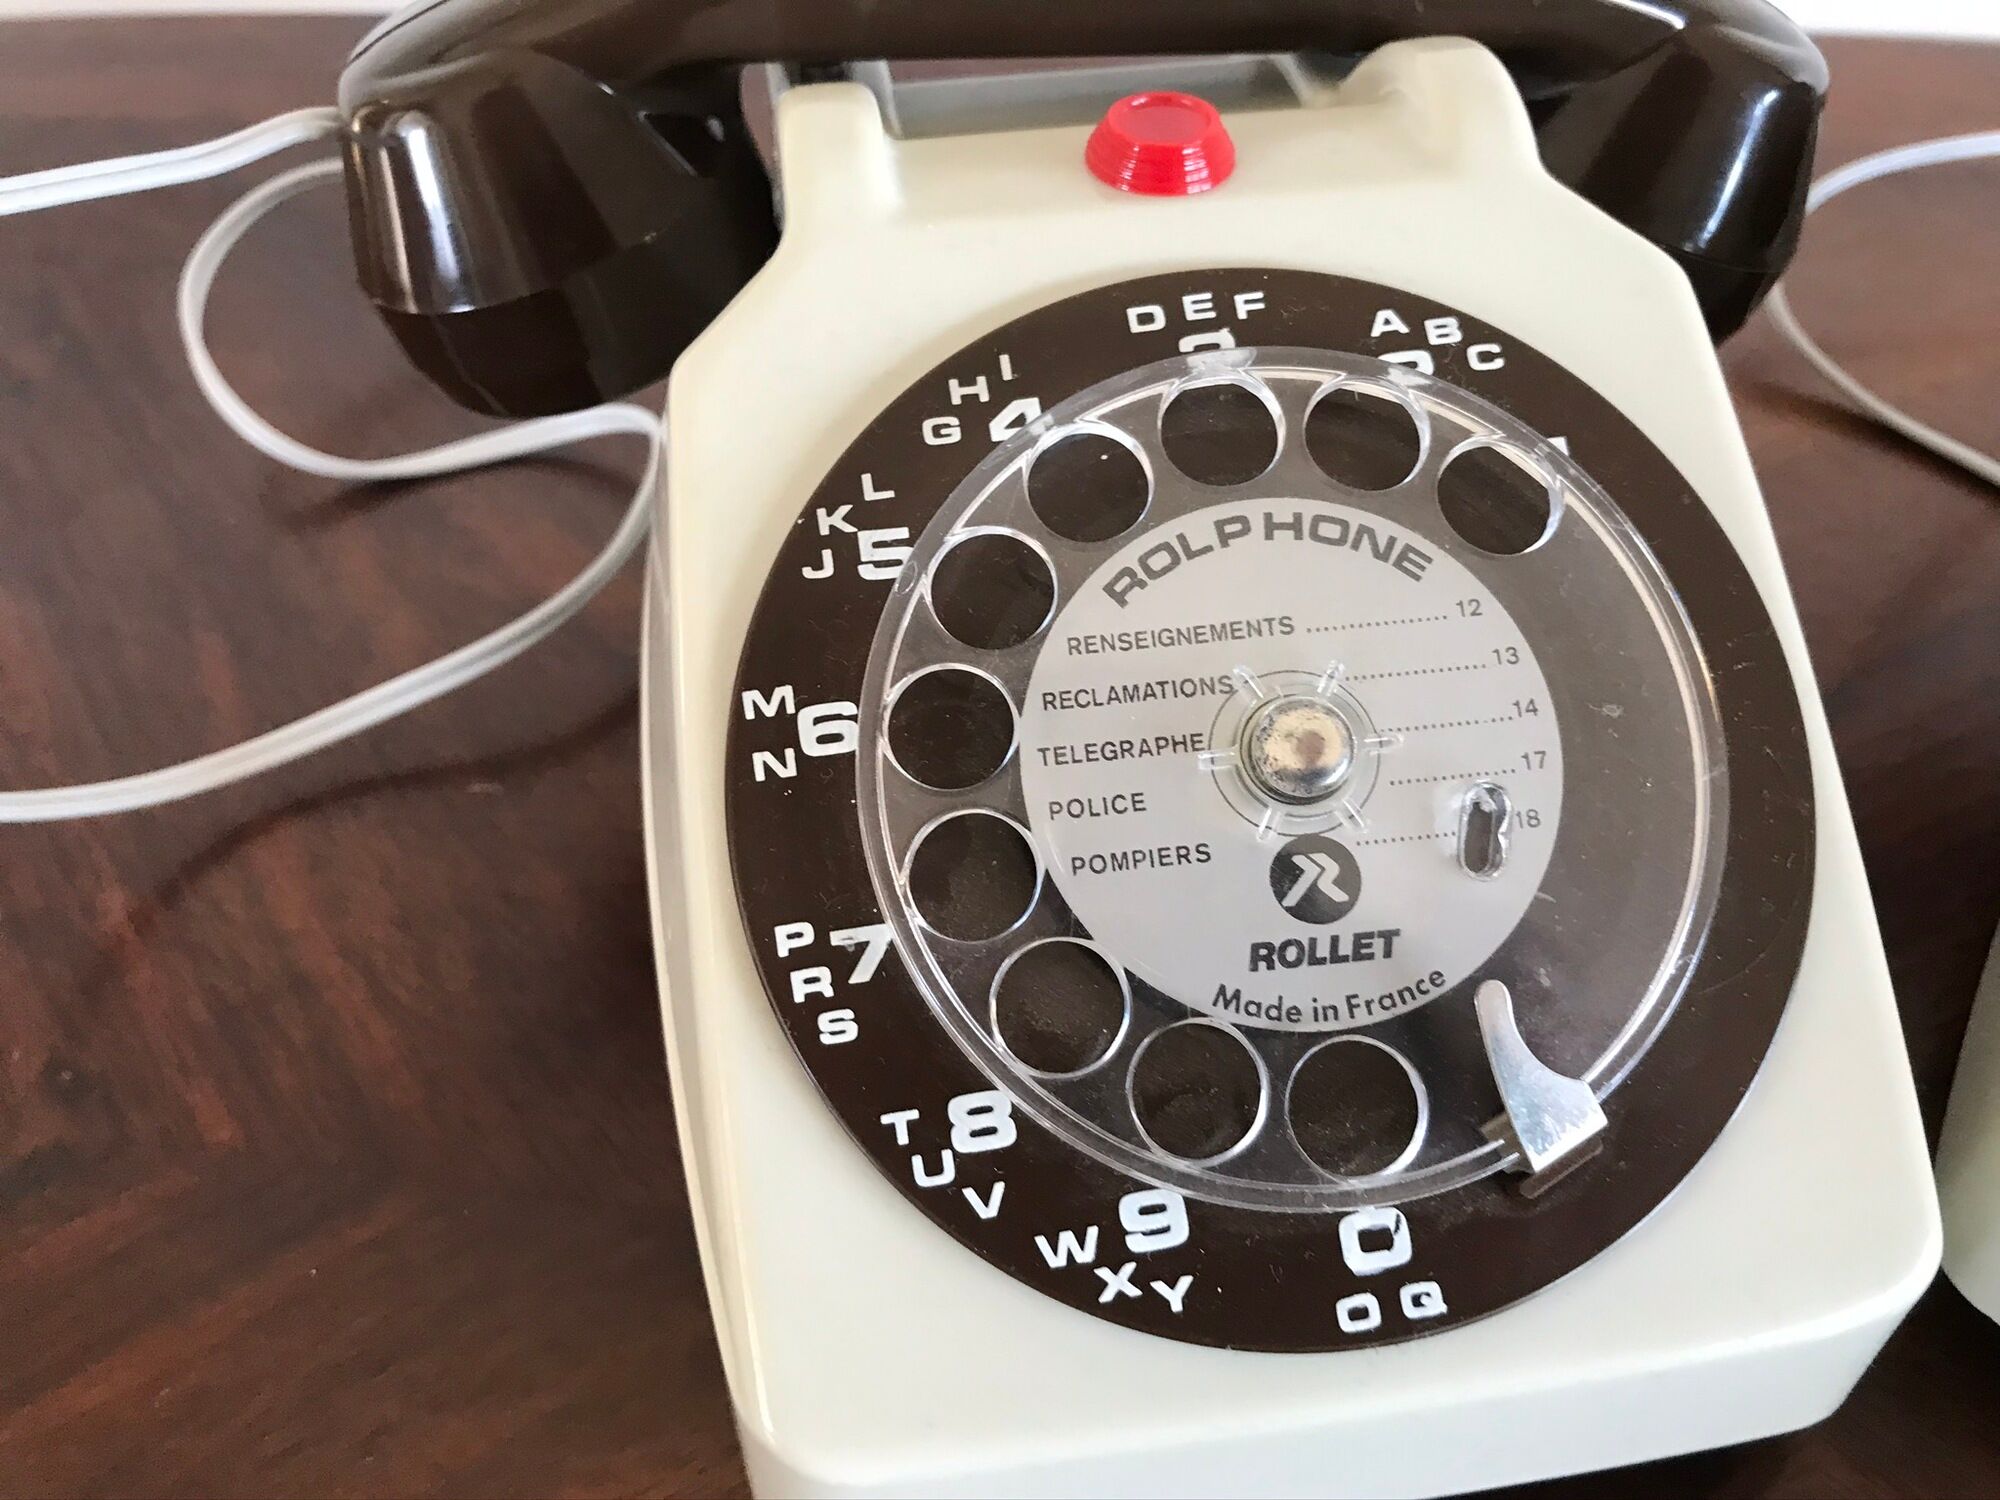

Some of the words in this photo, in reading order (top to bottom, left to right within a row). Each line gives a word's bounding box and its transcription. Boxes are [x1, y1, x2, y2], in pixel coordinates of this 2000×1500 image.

[857, 526, 914, 581] 5
[1101, 511, 1433, 609] ROLPHONE
[1066, 616, 1295, 656] RENSEIGNEMENTS
[1456, 598, 1483, 619] 12
[1041, 675, 1235, 711] RECLAMATIONS
[1492, 647, 1520, 667] 13
[797, 701, 858, 757] 6
[1036, 733, 1206, 767] TELEGRAPHE
[1512, 699, 1539, 720] 14
[1048, 792, 1147, 821] POLICE
[1521, 751, 1547, 771] 17
[1070, 843, 1212, 876] POMPIERS
[1516, 809, 1542, 829] 18
[830, 923, 894, 984] 7
[1248, 928, 1400, 973] ROLLET
[1211, 983, 1301, 1023] Made
[1311, 998, 1339, 1021] in
[1345, 969, 1446, 1018] France
[947, 1089, 1018, 1154] 8
[1118, 1188, 1190, 1253] 9
